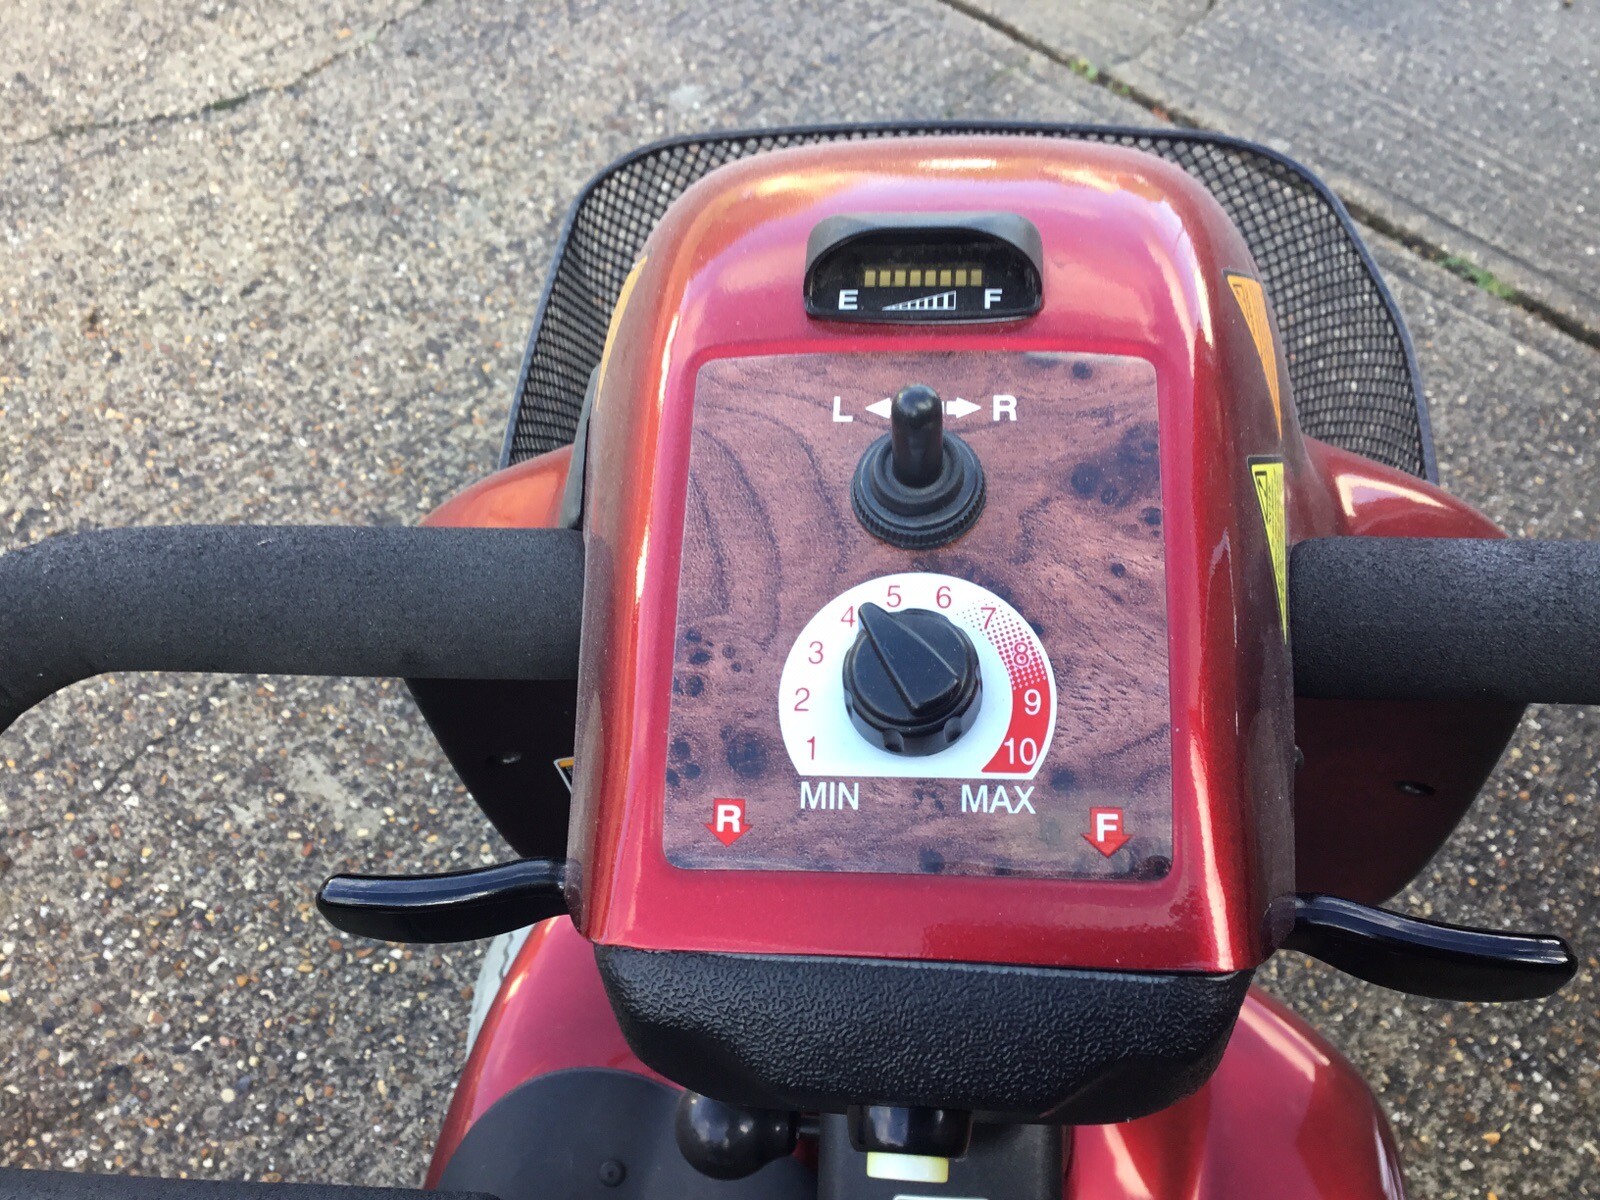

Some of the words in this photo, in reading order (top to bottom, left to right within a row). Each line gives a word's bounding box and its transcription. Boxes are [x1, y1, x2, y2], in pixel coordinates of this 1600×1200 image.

[838, 289, 859, 311] E
[984, 288, 1003, 310] F
[832, 396, 854, 423] L
[992, 394, 1018, 422] R
[887, 585, 902, 608] 5
[936, 586, 952, 609] 6
[840, 605, 856, 628] 4
[980, 607, 997, 630] 7
[808, 641, 825, 665] 3
[1013, 642, 1031, 667] 8
[793, 687, 810, 712] 2
[1023, 689, 1042, 716] 9
[806, 735, 817, 761] 1
[1003, 738, 1038, 766] 10
[800, 781, 860, 811] MIN
[961, 784, 1037, 815] MAX
[716, 804, 742, 833] R
[1096, 813, 1119, 842] F
